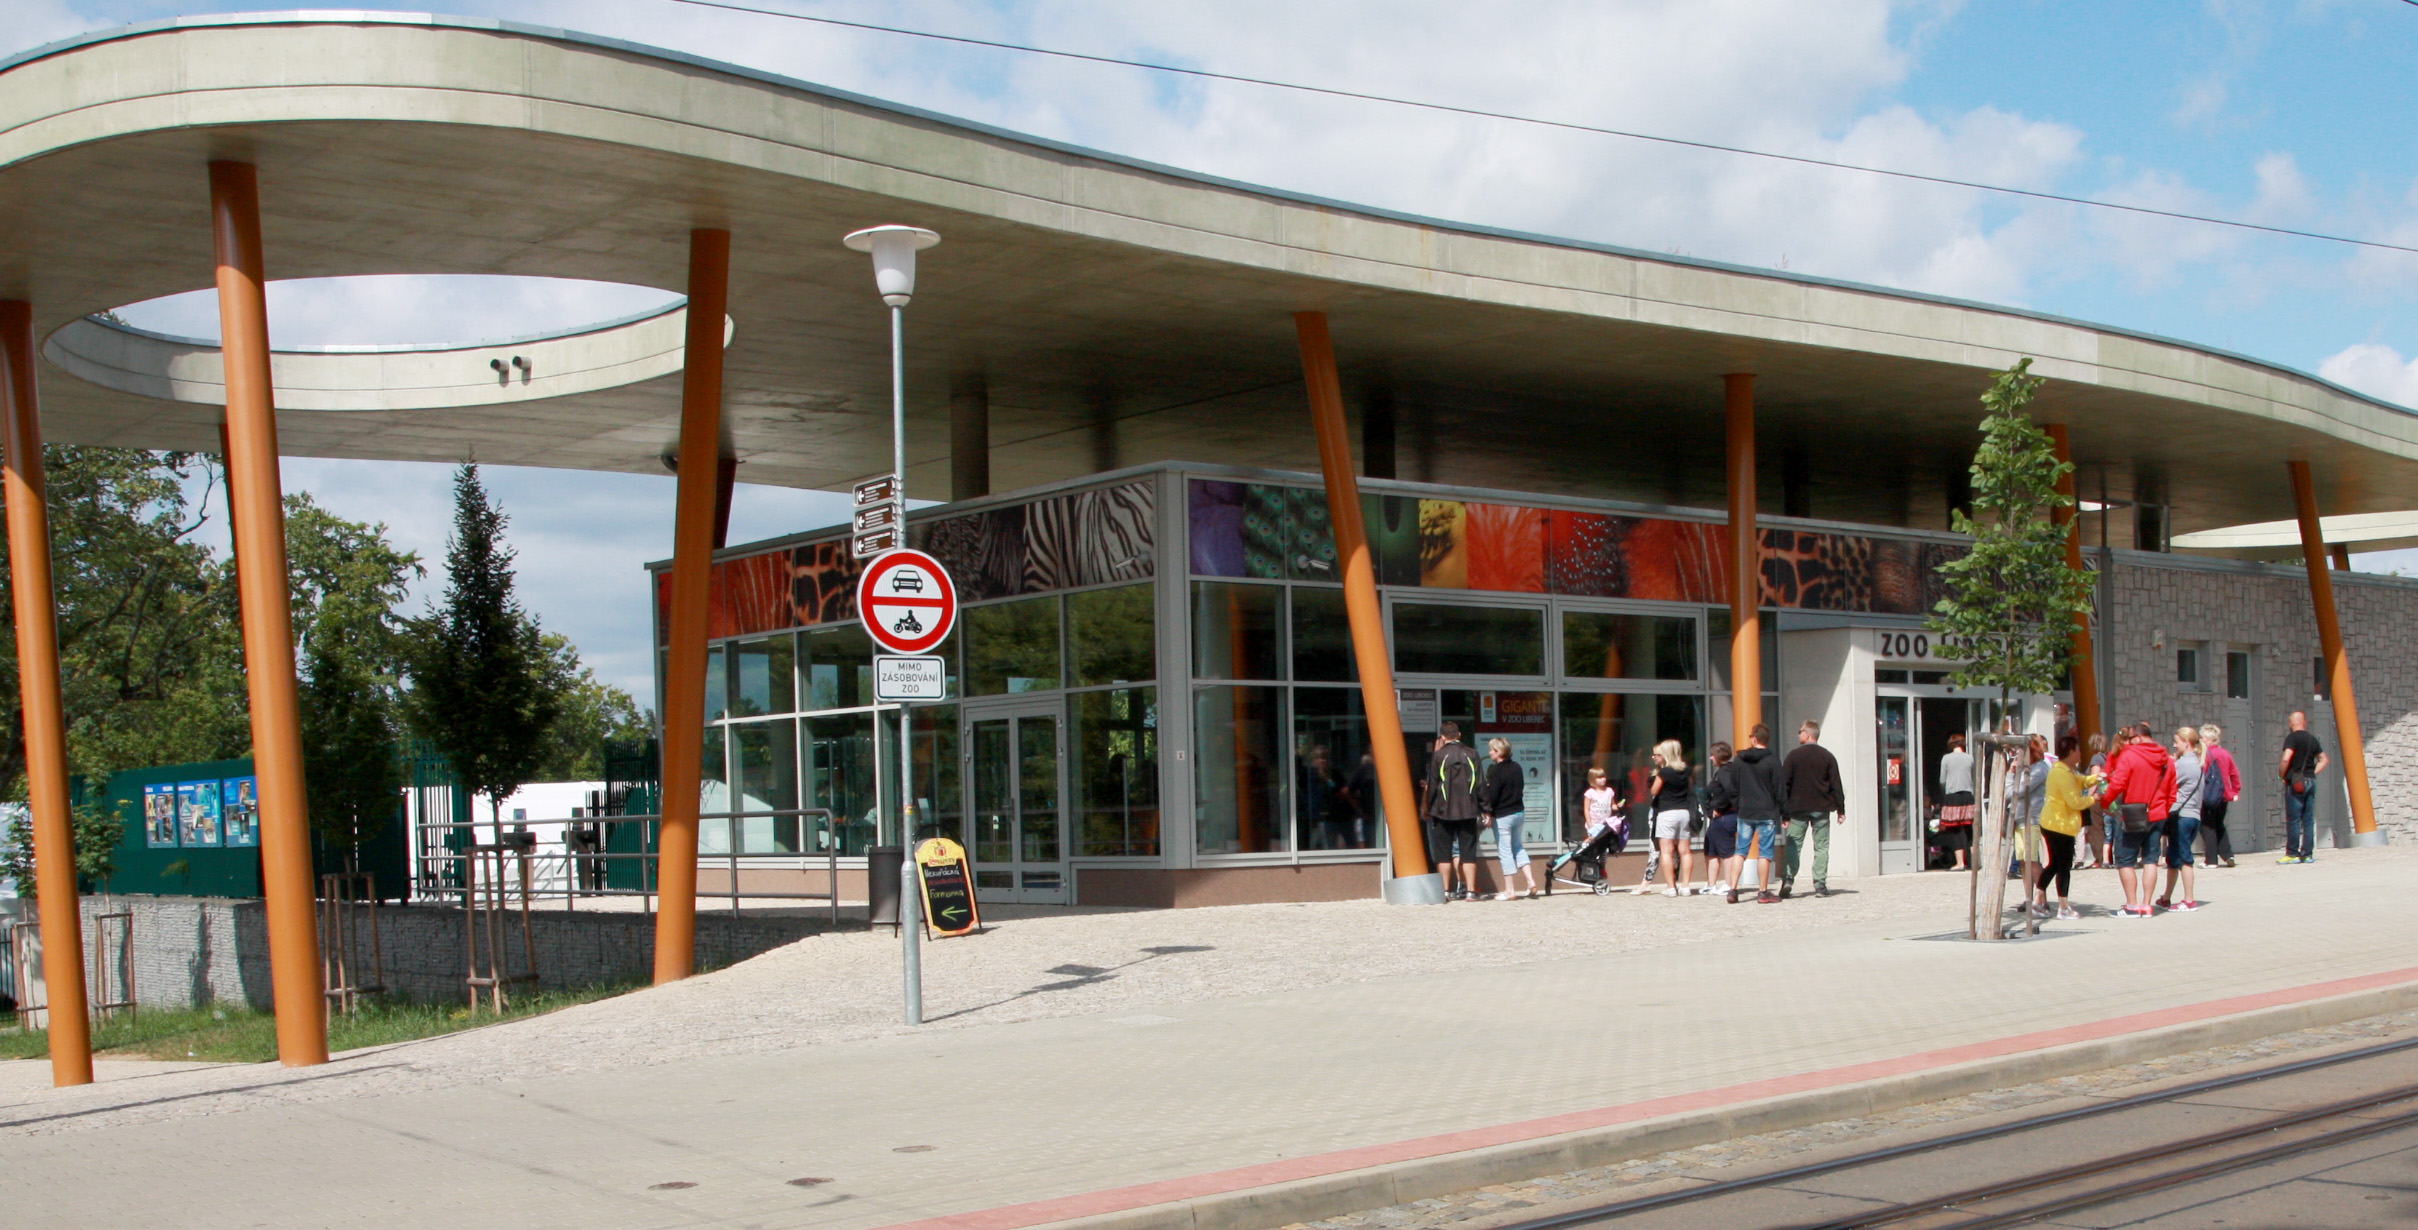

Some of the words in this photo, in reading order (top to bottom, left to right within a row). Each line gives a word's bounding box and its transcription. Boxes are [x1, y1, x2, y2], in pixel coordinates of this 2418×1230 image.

[1881, 633, 1928, 658] ZOO
[898, 662, 922, 671] MIMO
[882, 671, 938, 682] ZÁSOBOVÁNÍ
[902, 684, 920, 693] ZOO
[1502, 715, 1508, 723] V
[1508, 715, 1521, 723] ZOO
[1522, 715, 1546, 723] LIBEREC
